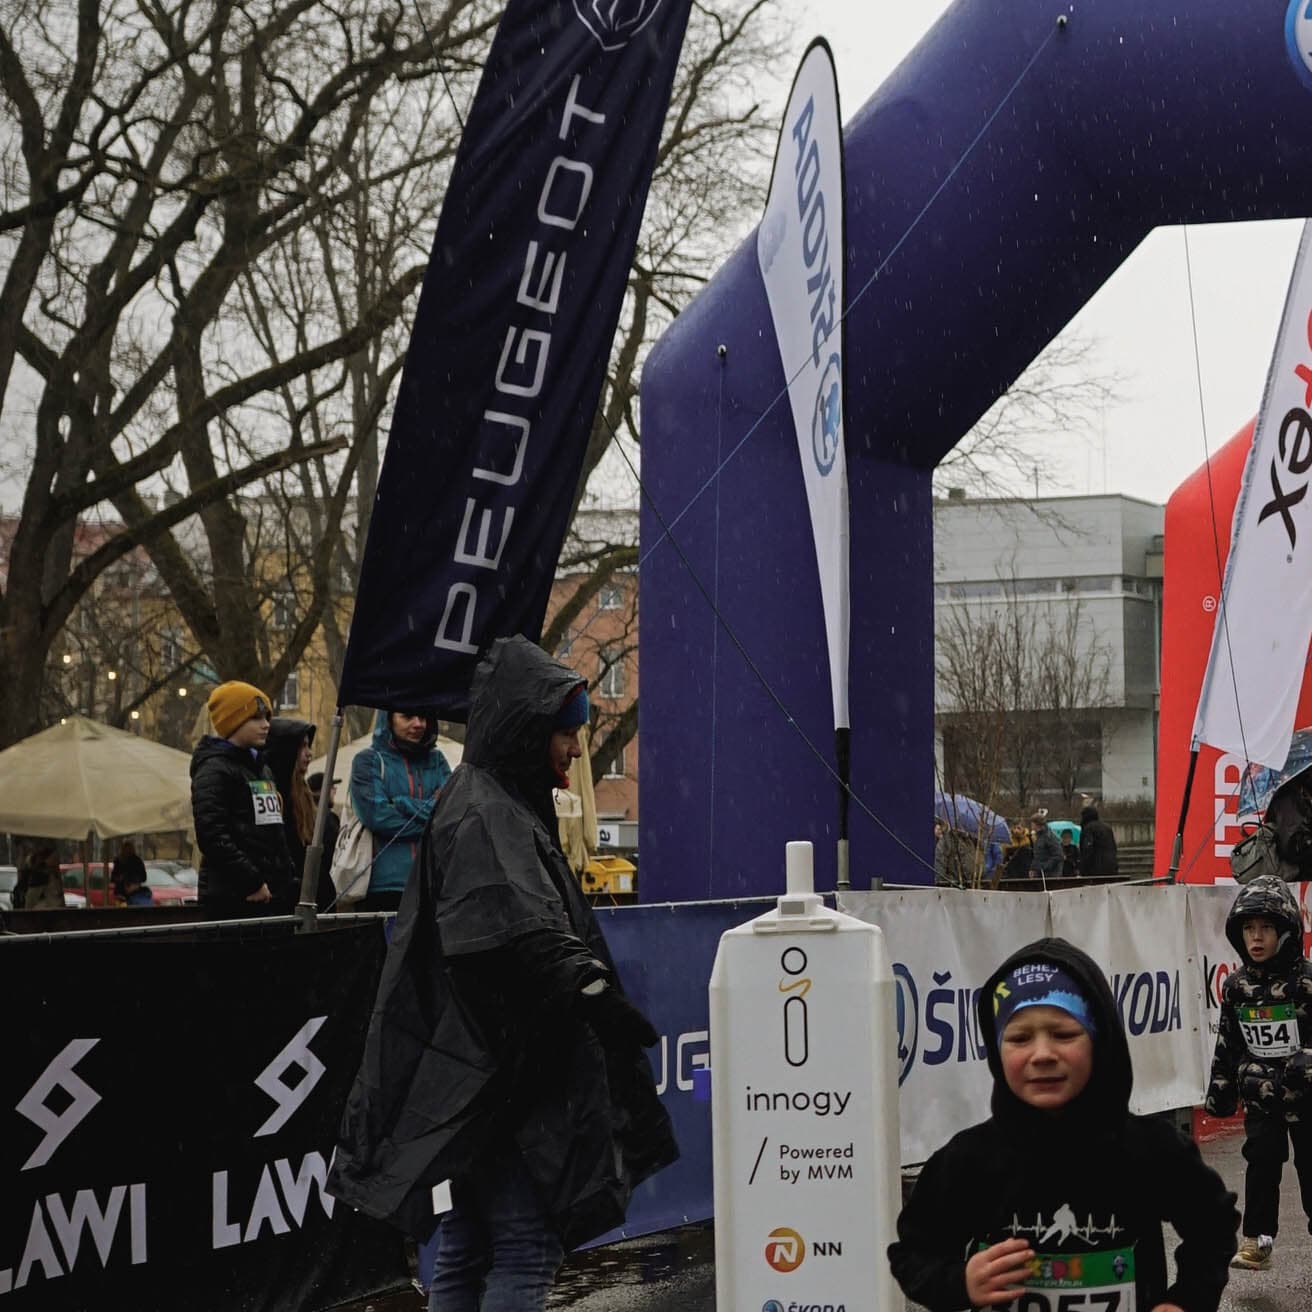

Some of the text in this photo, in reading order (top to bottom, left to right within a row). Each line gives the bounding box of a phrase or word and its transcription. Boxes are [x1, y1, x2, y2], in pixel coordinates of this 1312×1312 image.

[435, 74, 606, 655] PEUGEOT
[1018, 974, 1053, 986] LESY
[1111, 970, 1181, 1036] KODA
[1243, 1024, 1290, 1046] 3154
[747, 1086, 851, 1116] innogy
[780, 1143, 853, 1159] Powered
[780, 1166, 853, 1184] by MVM
[213, 1145, 337, 1249] LAW
[813, 1242, 842, 1256] NN
